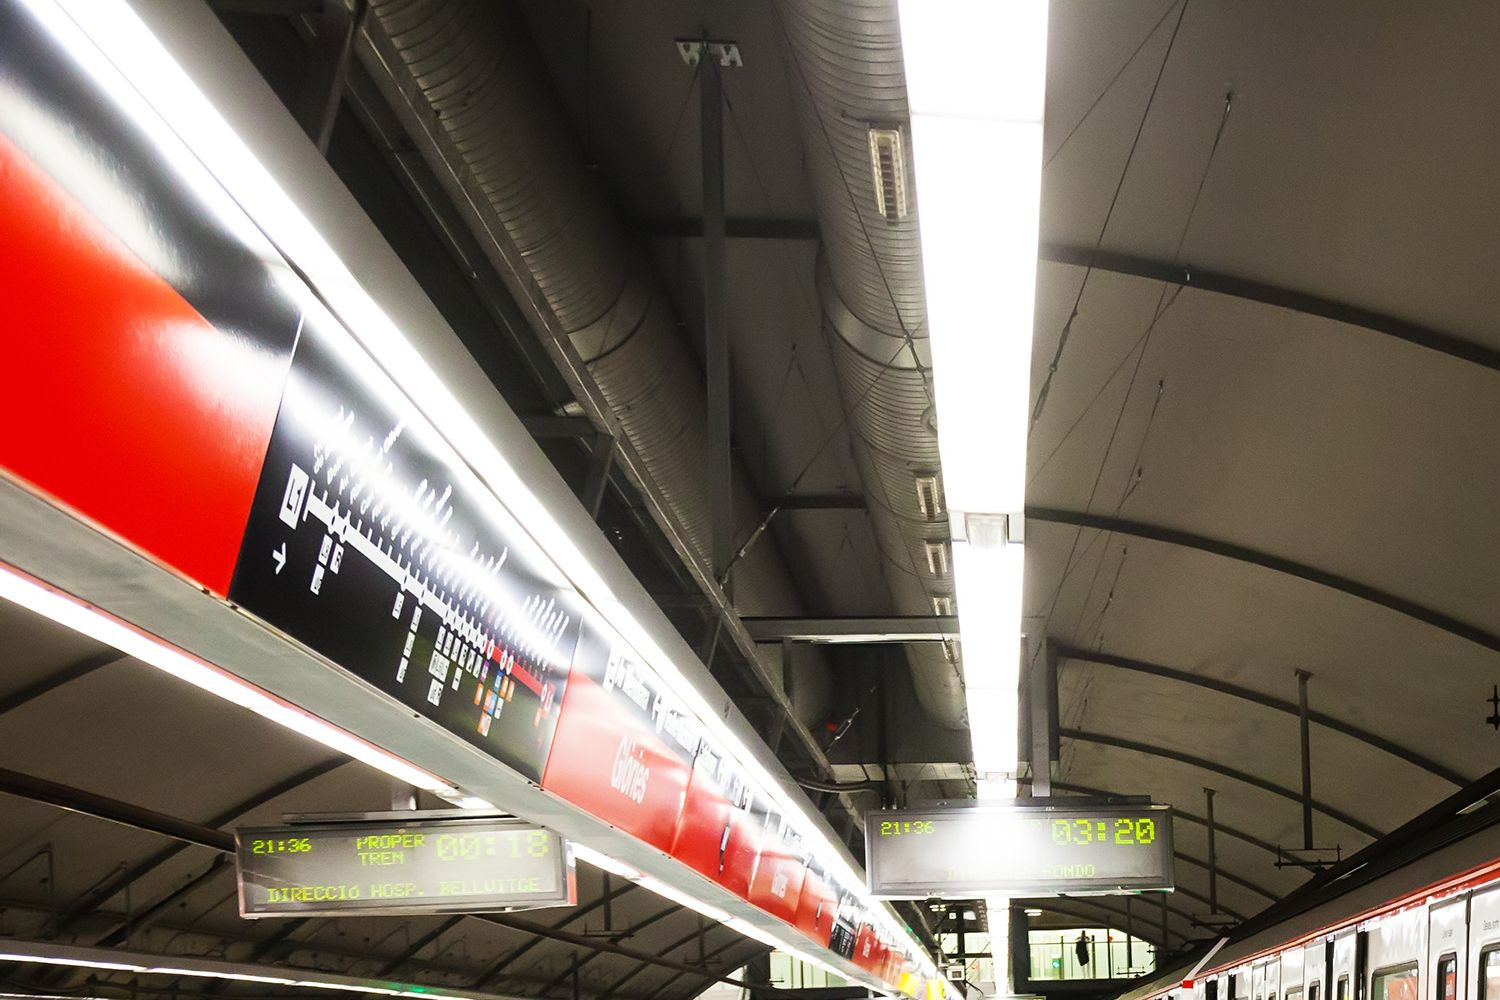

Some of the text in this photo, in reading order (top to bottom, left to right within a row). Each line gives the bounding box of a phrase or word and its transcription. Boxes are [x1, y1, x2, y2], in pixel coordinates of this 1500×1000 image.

[881, 821, 935, 836] 21:36
[1051, 818, 1155, 845] 03:20
[252, 838, 313, 854] 21:36
[356, 834, 425, 849] PROPER
[436, 831, 549, 862] 00:18
[370, 881, 425, 899] HOSP.
[439, 877, 540, 896] BELLVITGE
